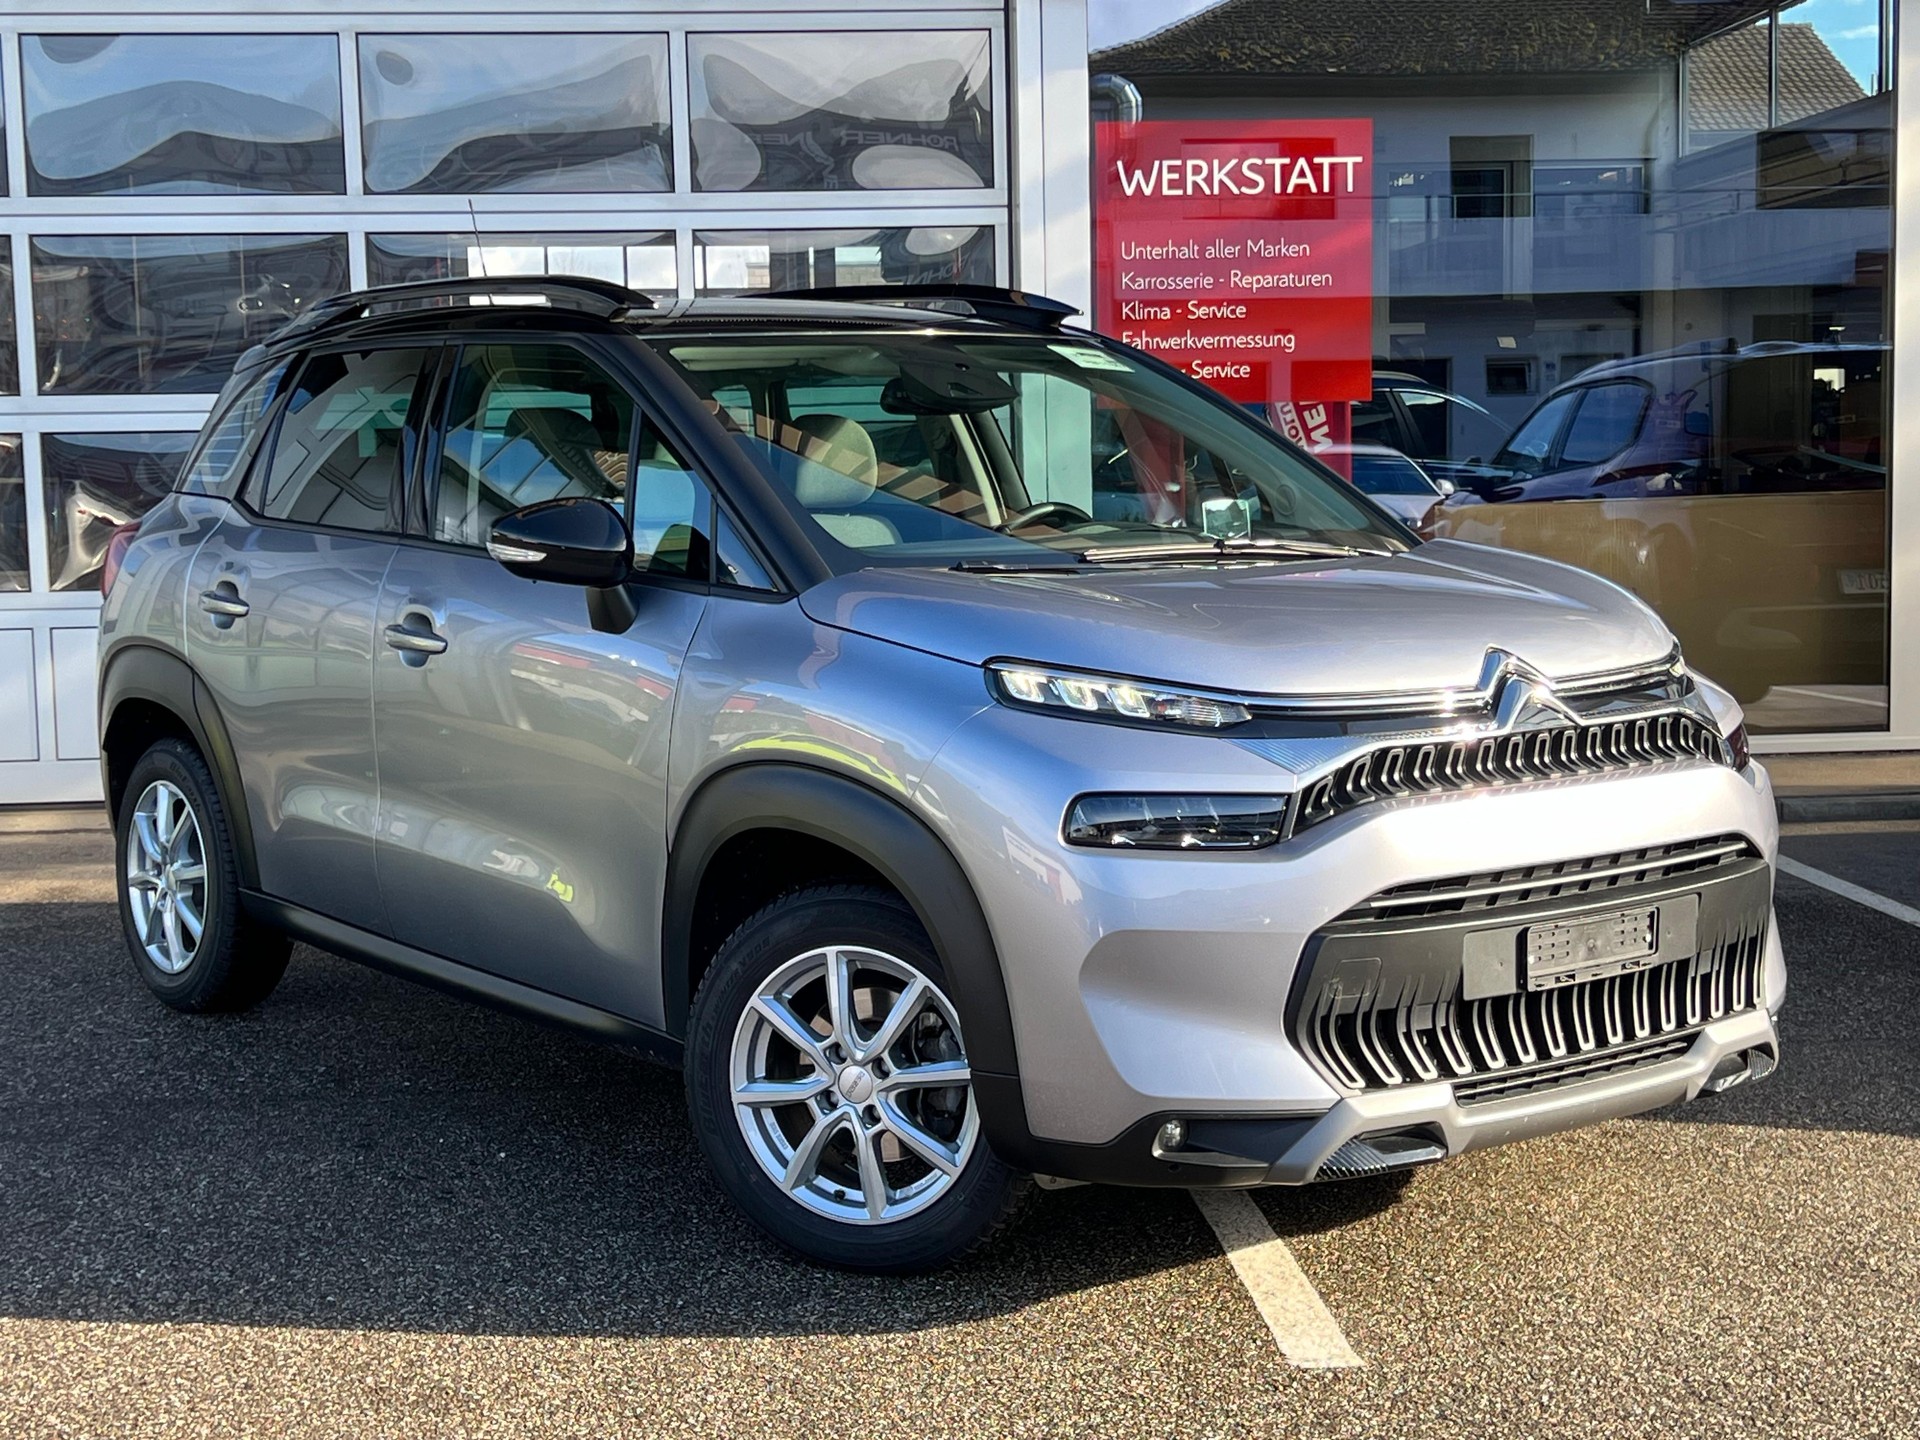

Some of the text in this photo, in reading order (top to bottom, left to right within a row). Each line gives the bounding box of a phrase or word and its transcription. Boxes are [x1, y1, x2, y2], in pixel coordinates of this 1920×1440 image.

[1116, 156, 1363, 196] WERKSTATT
[1121, 238, 1310, 260] Unterhalt aller Marken
[1121, 272, 1214, 290] Karrosserie
[1230, 270, 1333, 292] Reparaturen
[1121, 302, 1171, 320] Klima
[1187, 300, 1247, 319] Service
[1122, 330, 1296, 352] Fahrwerkvermessung
[1191, 360, 1251, 379] Service
